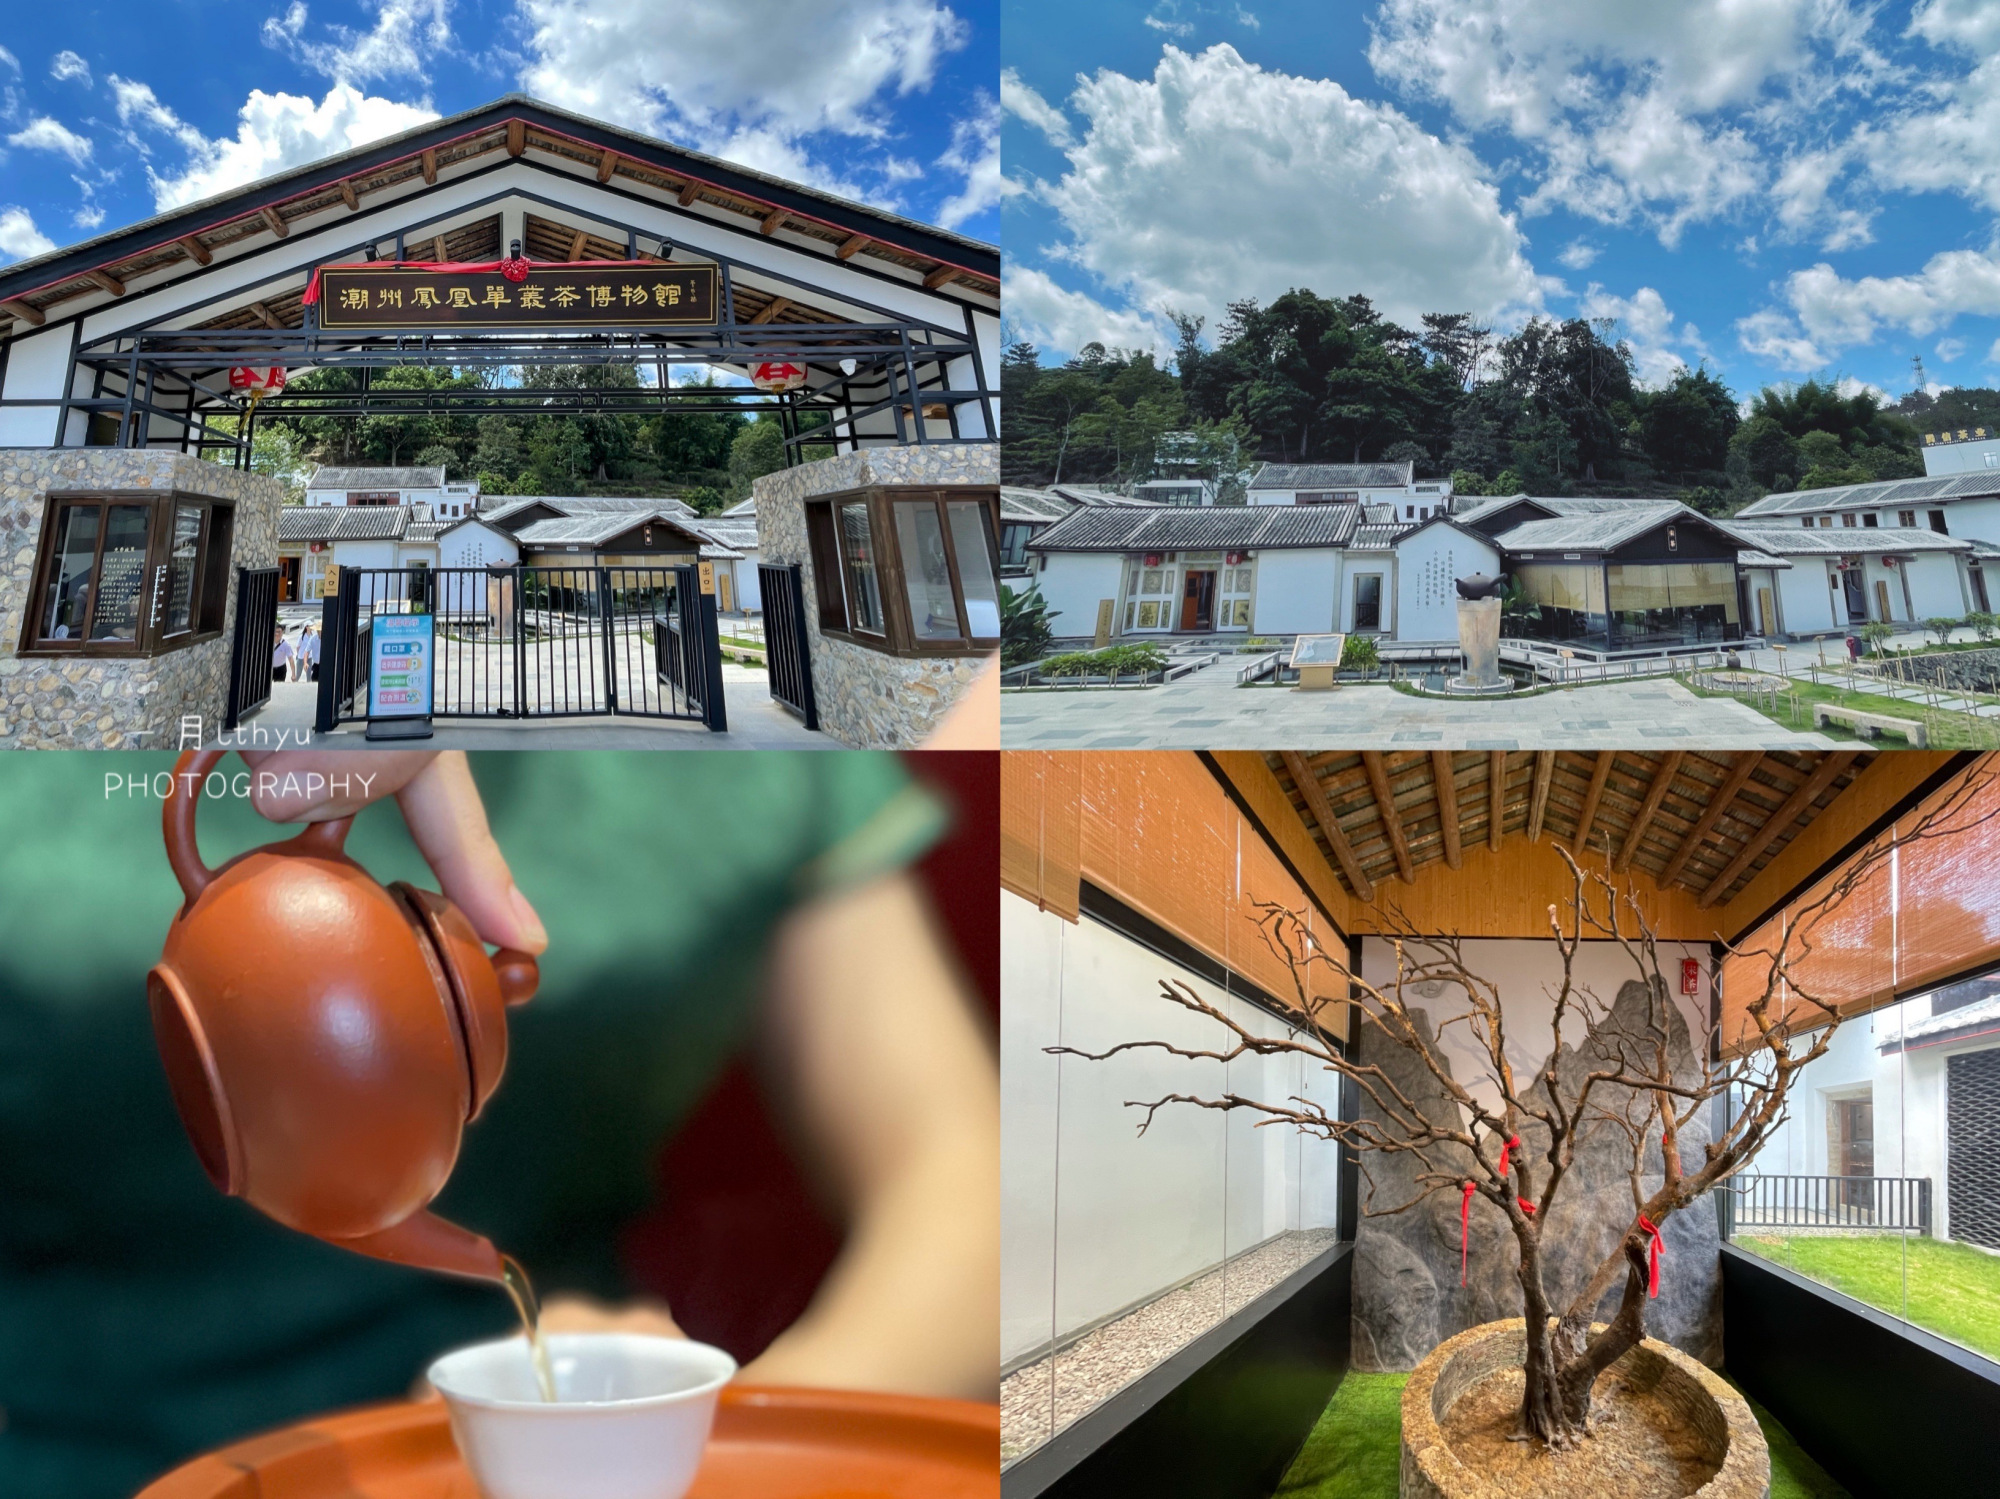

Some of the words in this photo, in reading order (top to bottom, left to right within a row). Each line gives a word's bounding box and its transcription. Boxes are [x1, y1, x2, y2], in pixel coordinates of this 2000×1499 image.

[339, 283, 683, 310] 潮州鳳凰單叢茶博物館
[328, 569, 337, 586] 入口
[702, 566, 710, 585] 出口
